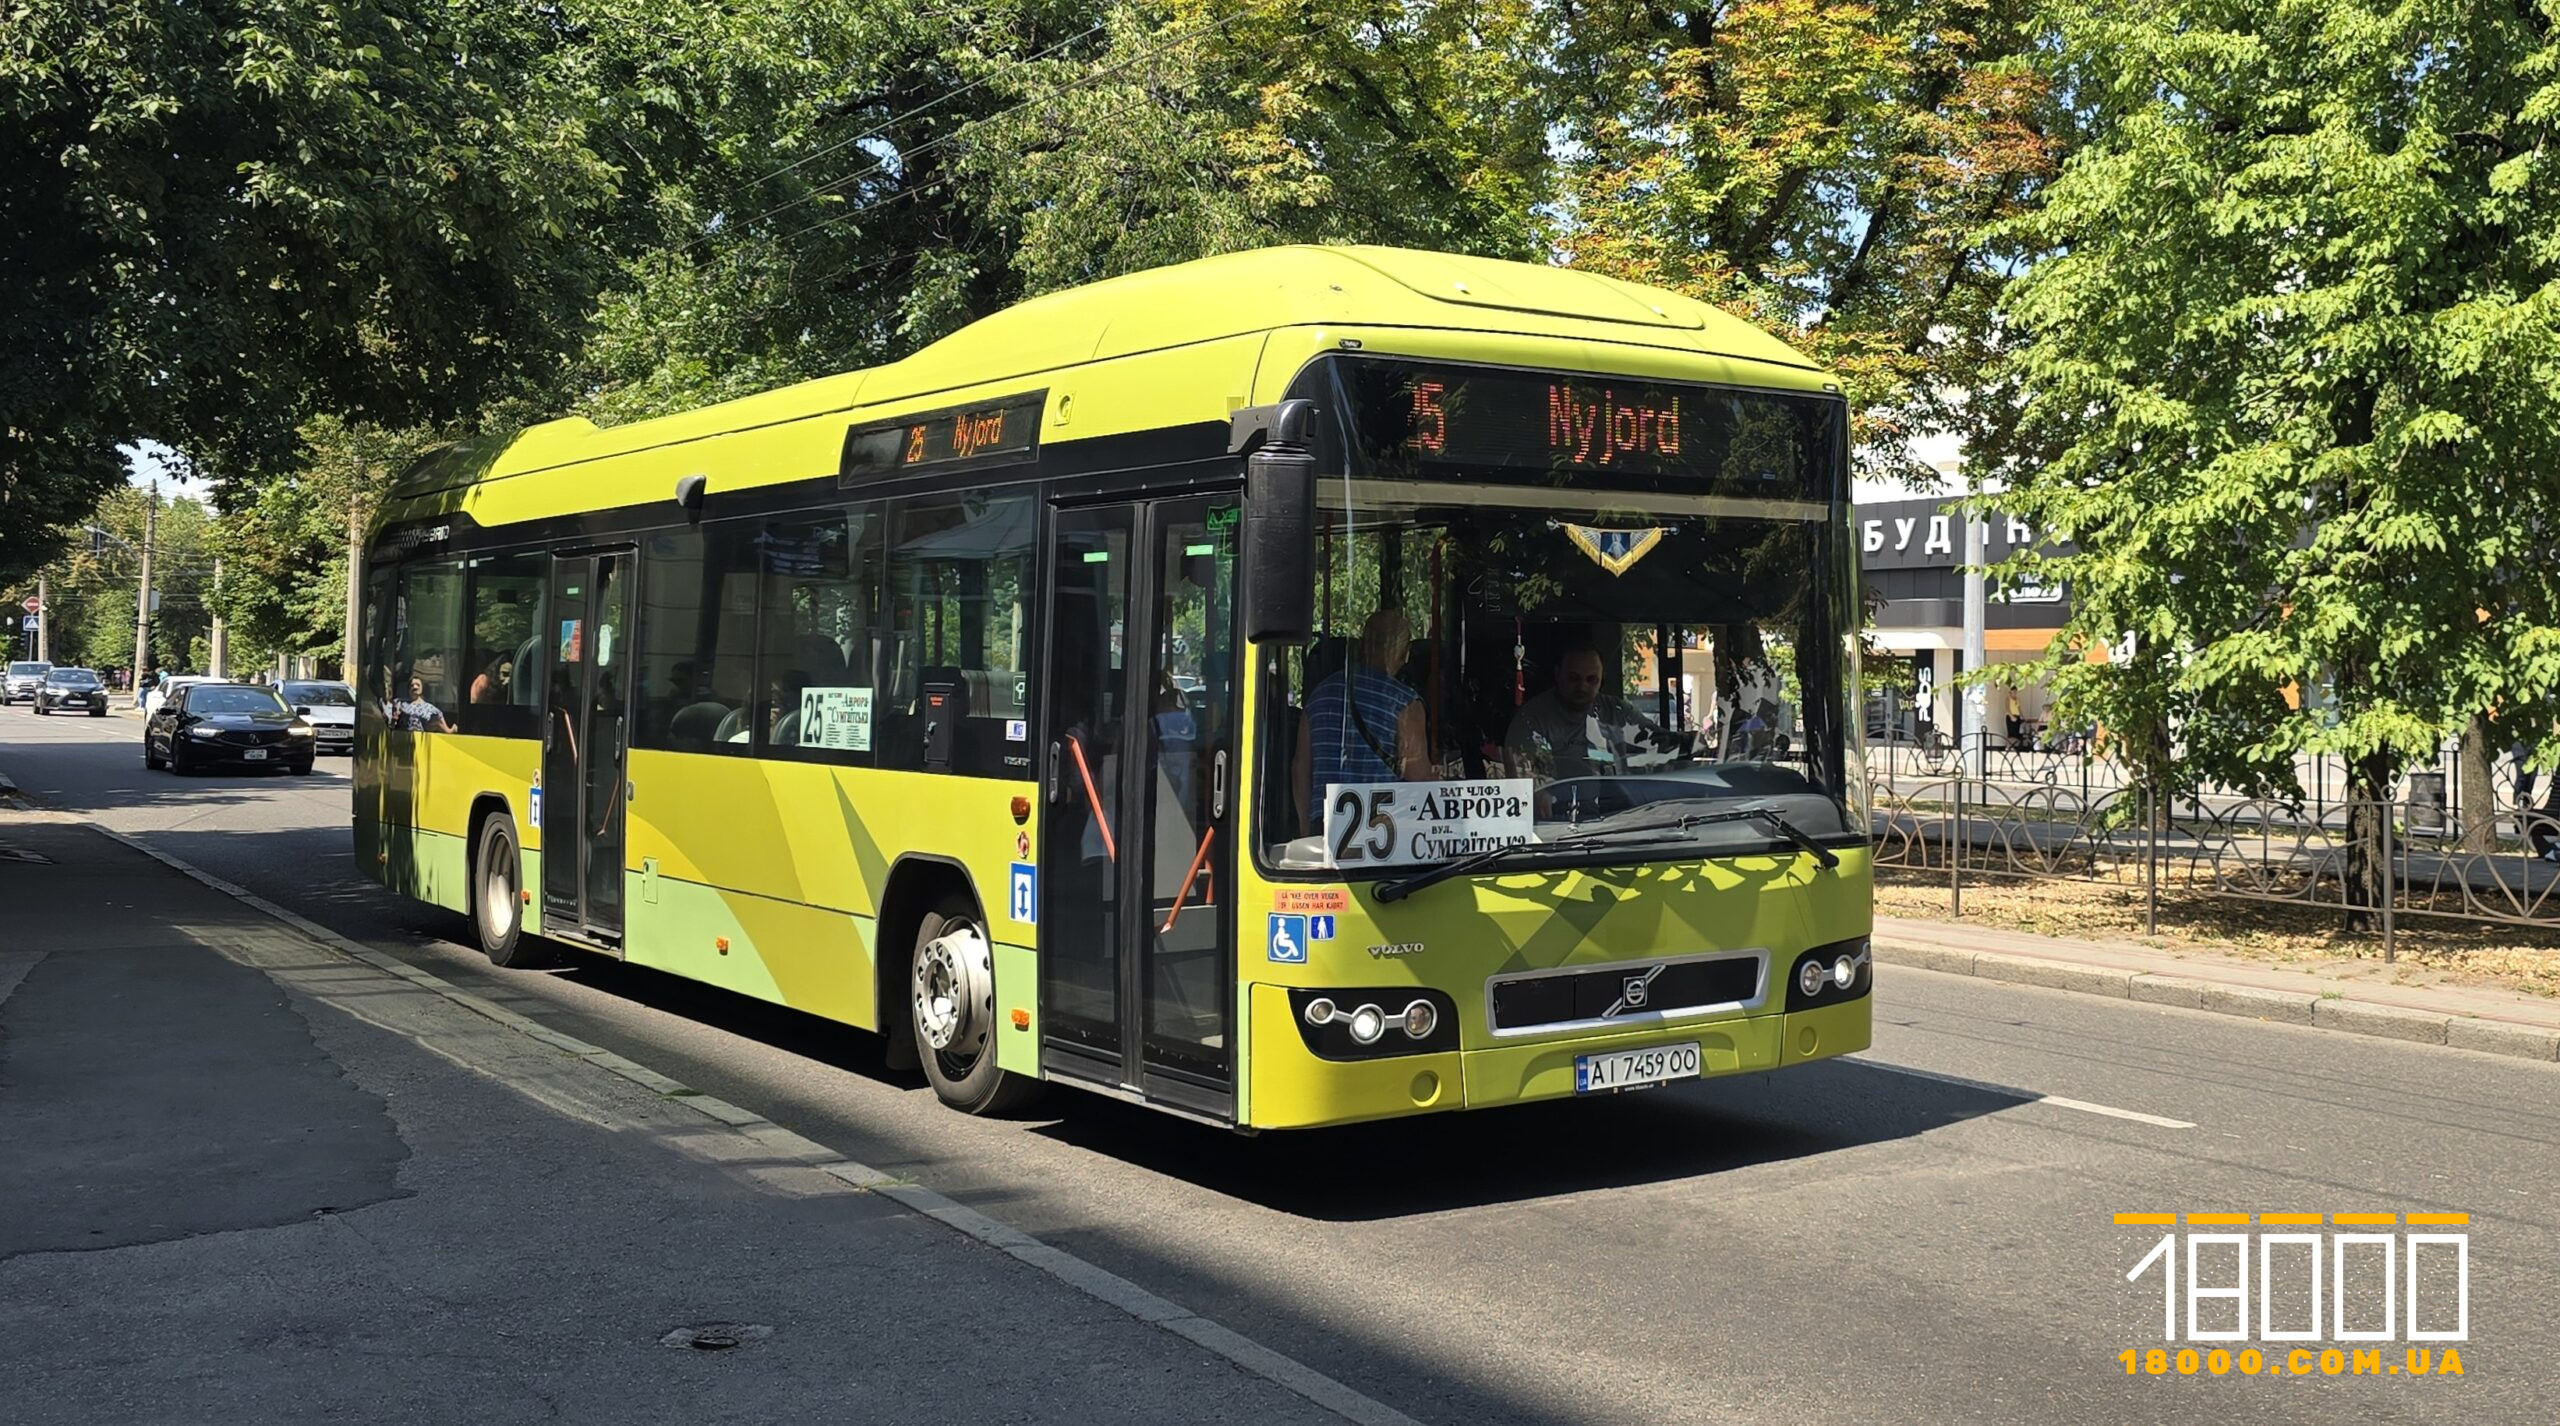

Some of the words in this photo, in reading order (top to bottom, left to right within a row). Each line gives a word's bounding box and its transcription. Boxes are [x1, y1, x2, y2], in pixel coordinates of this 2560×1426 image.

[906, 424, 927, 463] 25
[953, 408, 1006, 458] Nyjord
[1549, 384, 1680, 465] Nyjord
[803, 693, 824, 744] 25
[1440, 786, 1464, 799] ВАТ
[1467, 785, 1501, 797] ЧЛФЗ
[1333, 788, 1398, 862] 25
[1368, 943, 1425, 958] VOLVO
[1592, 1060, 1614, 1085] AI
[1624, 1053, 1665, 1081] 7459
